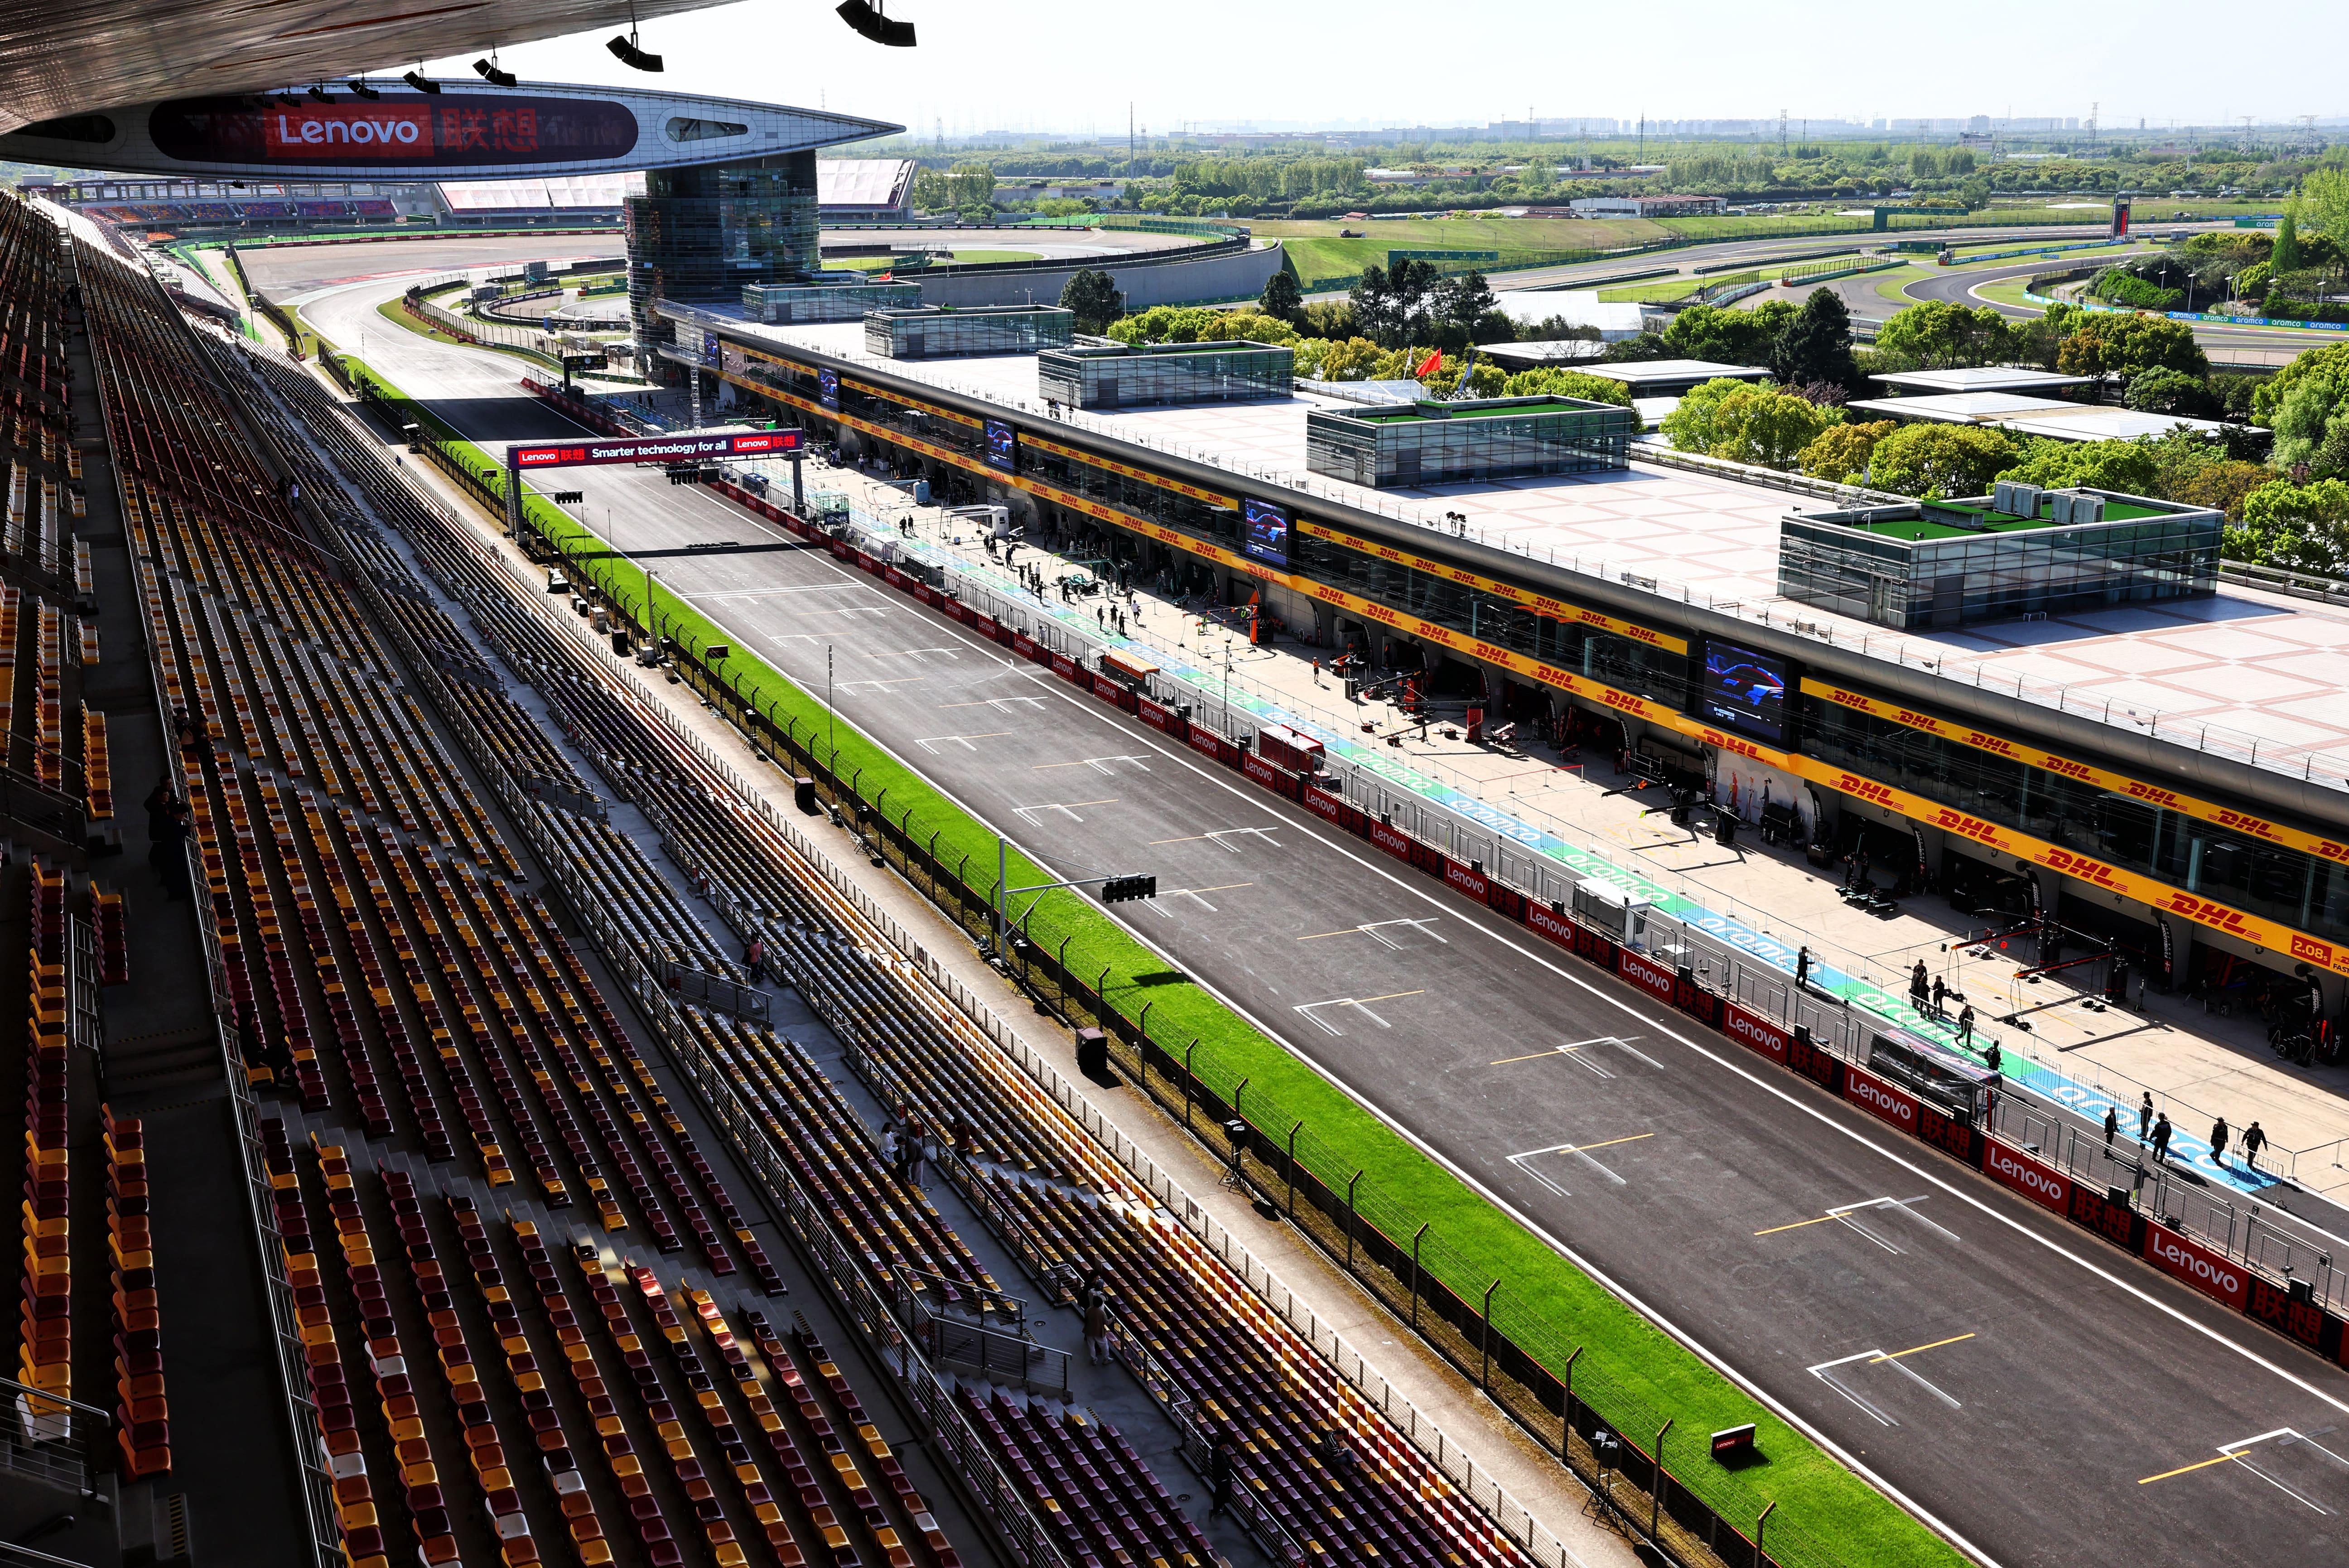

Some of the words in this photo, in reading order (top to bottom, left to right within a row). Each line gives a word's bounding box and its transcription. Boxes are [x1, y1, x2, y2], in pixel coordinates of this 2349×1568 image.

[279, 115, 418, 143] Lenovo
[440, 108, 539, 152] 联想
[2310, 321, 2341, 329] aramco
[801, 400, 811, 409] DHL
[852, 419, 863, 429] DHL
[871, 426, 883, 435] DHL
[737, 439, 769, 449] Lenovo
[772, 435, 796, 447] 联想
[891, 433, 903, 443] DHL
[912, 440, 925, 451] DHL
[1028, 437, 1039, 446] DHL
[1048, 443, 1059, 452] DHL
[521, 453, 556, 461] Lenovo
[560, 449, 585, 461] 联想
[592, 447, 635, 458] Smarter
[638, 443, 696, 456] technology
[698, 441, 712, 451] for
[714, 440, 727, 450] all
[934, 449, 947, 459] DHL
[1068, 449, 1080, 458] DHL
[957, 457, 970, 468] DHL
[1089, 456, 1101, 466] DHL
[1111, 463, 1123, 472] DHL
[989, 470, 1009, 484] DHL
[1134, 470, 1146, 480] DHL
[1158, 477, 1171, 487] DHL
[1032, 484, 1048, 496] DHL
[1061, 493, 1078, 507] DHL
[1182, 485, 1196, 496] DHL
[1208, 493, 1223, 505] DHL
[1091, 505, 1110, 519] DHL
[787, 517, 799, 530] Lenovo
[1124, 516, 1144, 531] DHL
[1312, 526, 1331, 540] DHL
[809, 529, 822, 542] Lenovo
[1158, 529, 1180, 545] DHL
[1345, 537, 1365, 550] DHL
[833, 541, 846, 555] Lenovo
[1196, 542, 1218, 559] DHL
[1379, 548, 1400, 560] DHL
[859, 554, 872, 569] Lenovo
[1415, 559, 1437, 573] DHL
[885, 568, 899, 584] Lenovo
[1246, 563, 1280, 584] DHL
[1453, 571, 1476, 586] DHL
[914, 584, 929, 599] Lenovo
[1318, 587, 1346, 607] DHL
[1493, 584, 1518, 598] DHL
[945, 599, 961, 617] Lenovo
[1367, 604, 1396, 625] DHL
[1536, 597, 1562, 613] DHL
[978, 617, 996, 634] Lenovo
[1581, 611, 1609, 627] DHL
[1419, 622, 1451, 644] DHL
[1629, 626, 1657, 644] DHL
[1014, 635, 1033, 655] Lenovo
[1476, 643, 1511, 666] DHL
[1053, 655, 1073, 675] Lenovo
[1537, 666, 1575, 690] DHL
[1095, 678, 1116, 699] Lenovo
[1604, 690, 1646, 716] DHL
[1834, 690, 1870, 711] DHL
[1141, 702, 1164, 724] Lenovo
[1899, 710, 1938, 732] DHL
[1191, 728, 1217, 753] Lenovo
[1703, 729, 1765, 763] DHL
[1969, 733, 2012, 756] DHL
[1245, 756, 1272, 782] Lenovo
[1356, 753, 1433, 790] aramco
[2045, 756, 2092, 781] DHL
[1274, 774, 1297, 800] 联想
[1840, 774, 1894, 806] DHL
[2128, 782, 2178, 808] DHL
[1306, 789, 1336, 816] Lenovo
[1341, 806, 1364, 835] 联想
[1450, 800, 1541, 841] aramco
[1937, 809, 1998, 844] DHL
[2217, 810, 2273, 838] DHL
[1373, 824, 1406, 853] Lenovo
[1411, 843, 1437, 874] 联想
[2047, 848, 2116, 887] DHL
[1447, 862, 1485, 894] Lenovo
[1564, 854, 1670, 902] aramco
[1490, 885, 1519, 918] 联想
[1529, 906, 1572, 940] Lenovo
[2169, 893, 2248, 936] DHL
[1577, 927, 1610, 965] 联想
[1698, 917, 1821, 974] aramco
[2294, 940, 2328, 961] 2.08s
[1622, 954, 1670, 992] Lenovo
[1677, 979, 1714, 1021] 联想
[1728, 1010, 1782, 1051] Lenovo
[2333, 1035, 2341, 1056] RACLE
[1791, 1040, 1833, 1085] 联想
[1849, 1073, 1911, 1120] Lenovo
[1921, 1108, 1971, 1158] 联想
[1990, 1147, 2062, 1200] Lenovo
[2072, 1186, 2132, 1243] 联想
[2153, 1232, 2239, 1293] Lenovo
[2252, 1279, 2323, 1346] 联想
[1716, 1439, 1736, 1449] Lenovo
